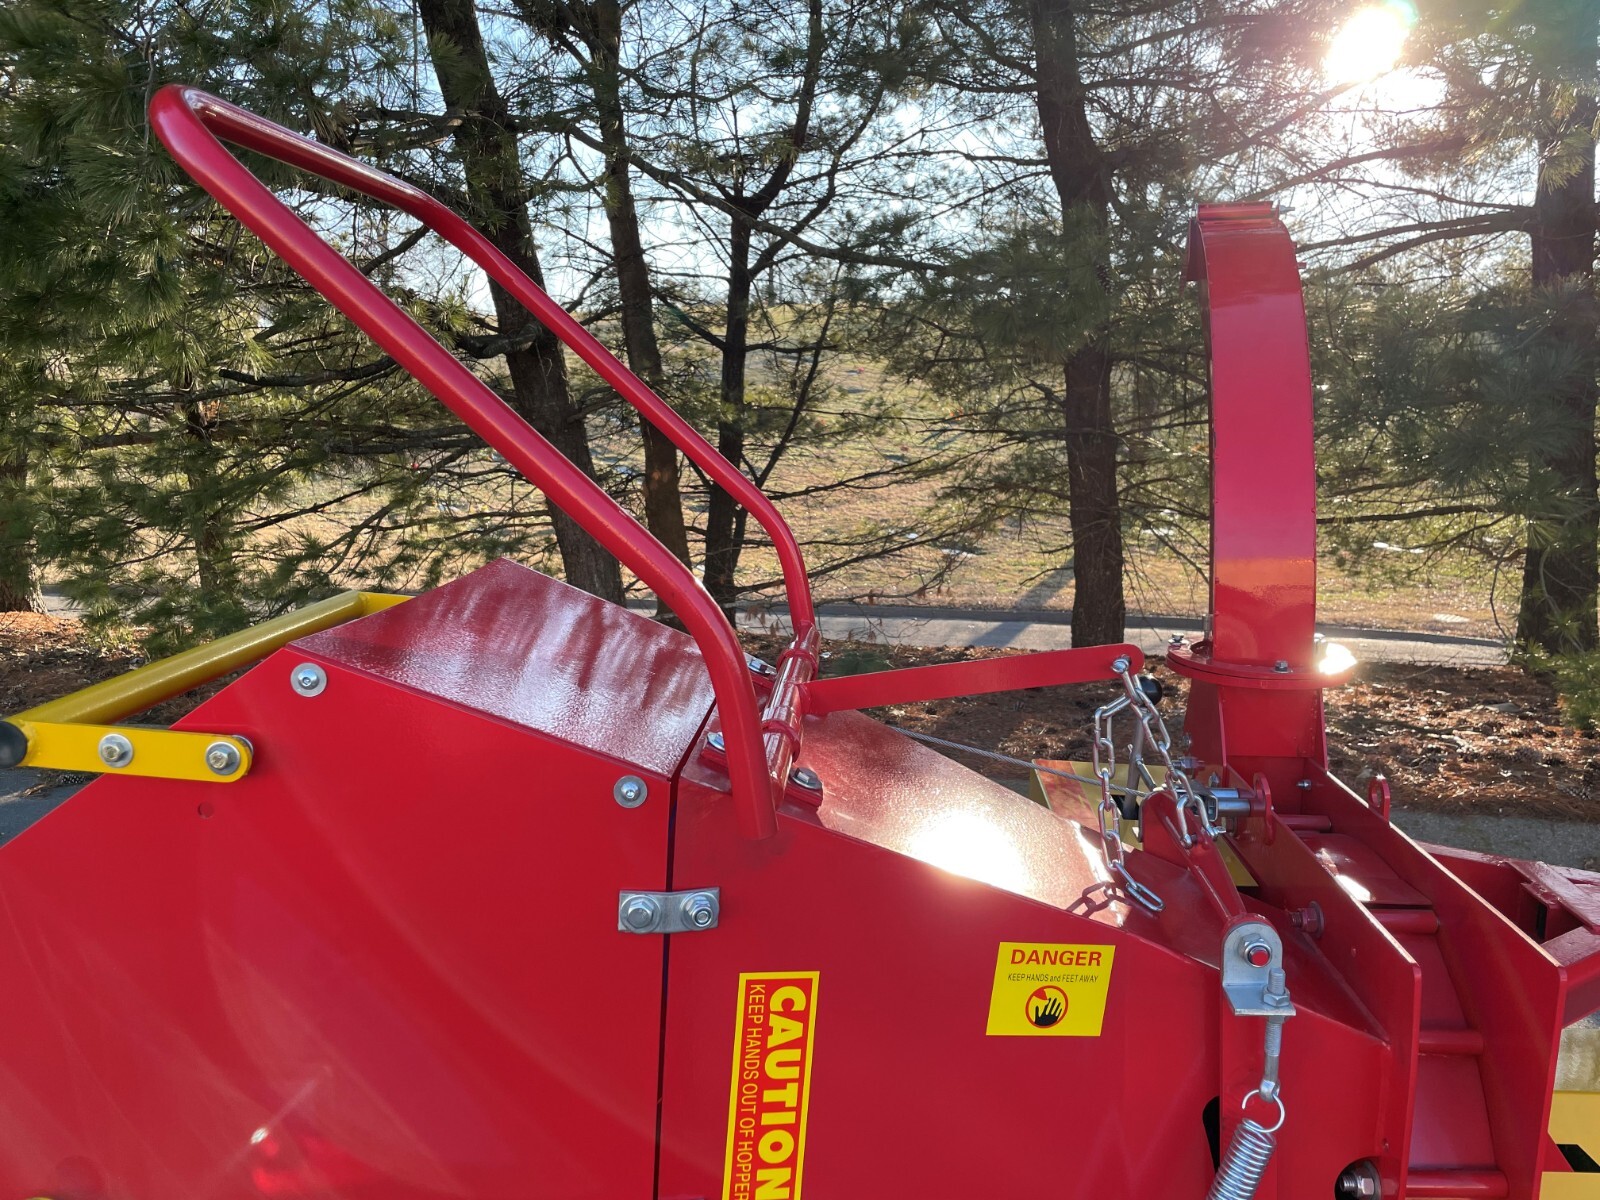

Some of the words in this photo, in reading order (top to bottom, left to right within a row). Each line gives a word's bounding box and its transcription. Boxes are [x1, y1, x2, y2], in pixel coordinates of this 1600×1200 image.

[1010, 949, 1102, 966] DANGER
[1007, 973, 1025, 982] KEEP
[1026, 974, 1049, 982] HANDS
[1062, 974, 1079, 983] FEET
[1079, 975, 1099, 983] AWAY
[748, 984, 766, 1024] KEEP
[743, 1028, 762, 1080] HANDS
[740, 1083, 758, 1114] OUT
[755, 985, 807, 1200] CAUTION
[739, 1117, 755, 1138] OF
